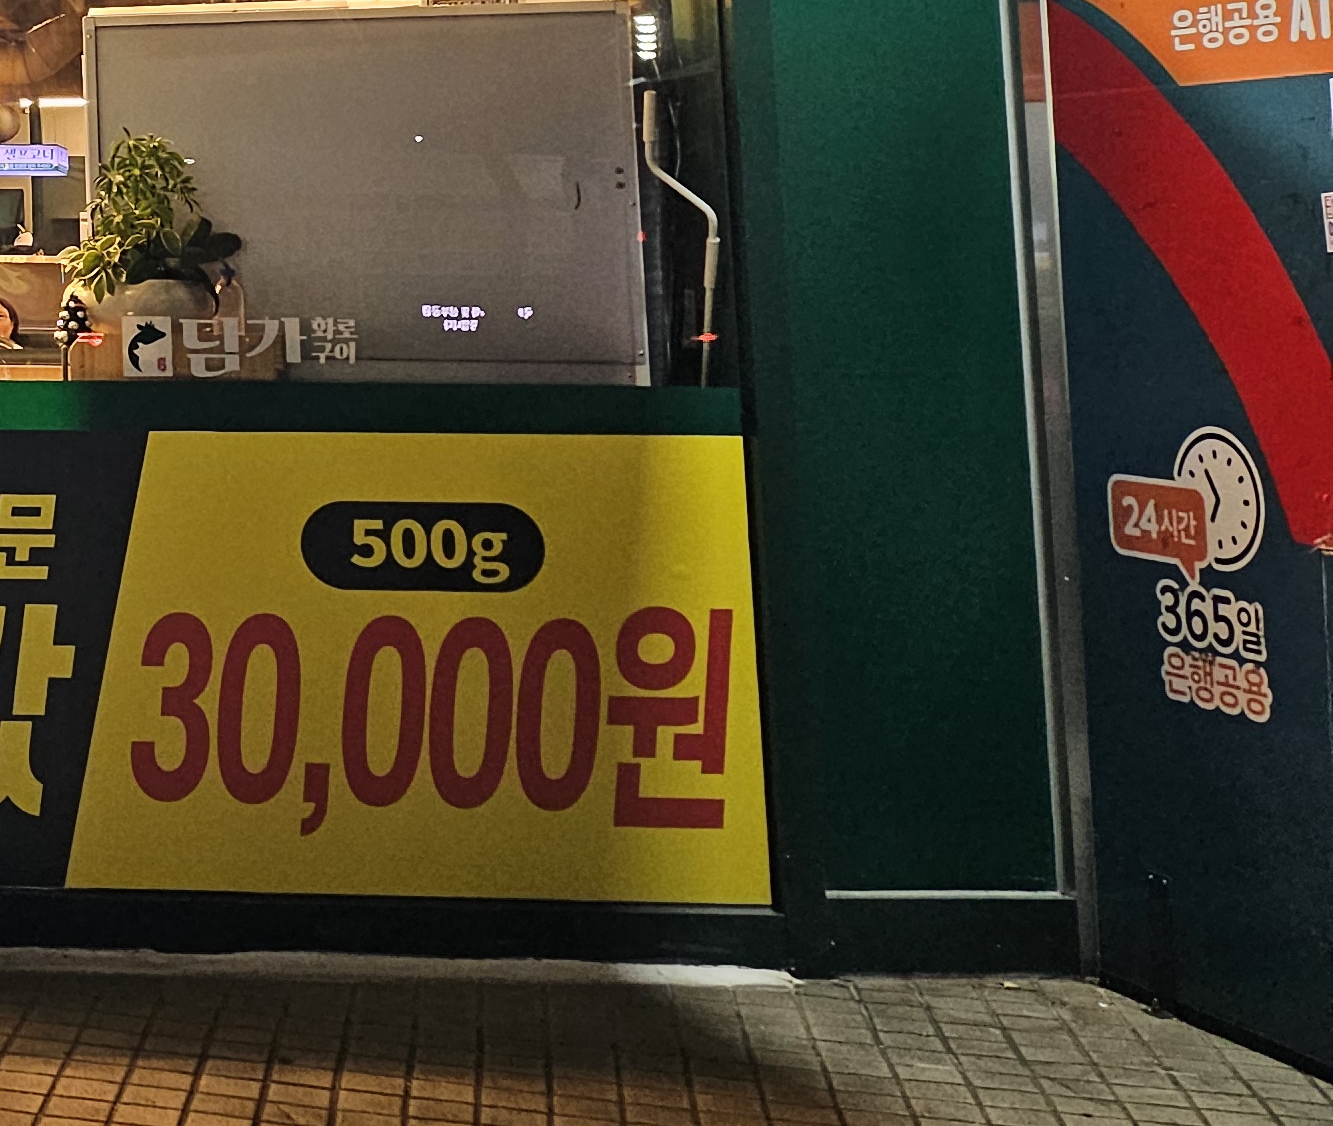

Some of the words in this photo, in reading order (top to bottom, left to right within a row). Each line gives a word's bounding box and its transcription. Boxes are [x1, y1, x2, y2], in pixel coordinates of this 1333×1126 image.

[178, 317, 308, 378] 담가
[310, 316, 359, 340] 화로
[310, 341, 356, 365] 구이
[1120, 495, 1198, 546] 24시간
[346, 518, 512, 585] 500g
[1159, 584, 1264, 656] 365일
[129, 604, 735, 839] 30,000원
